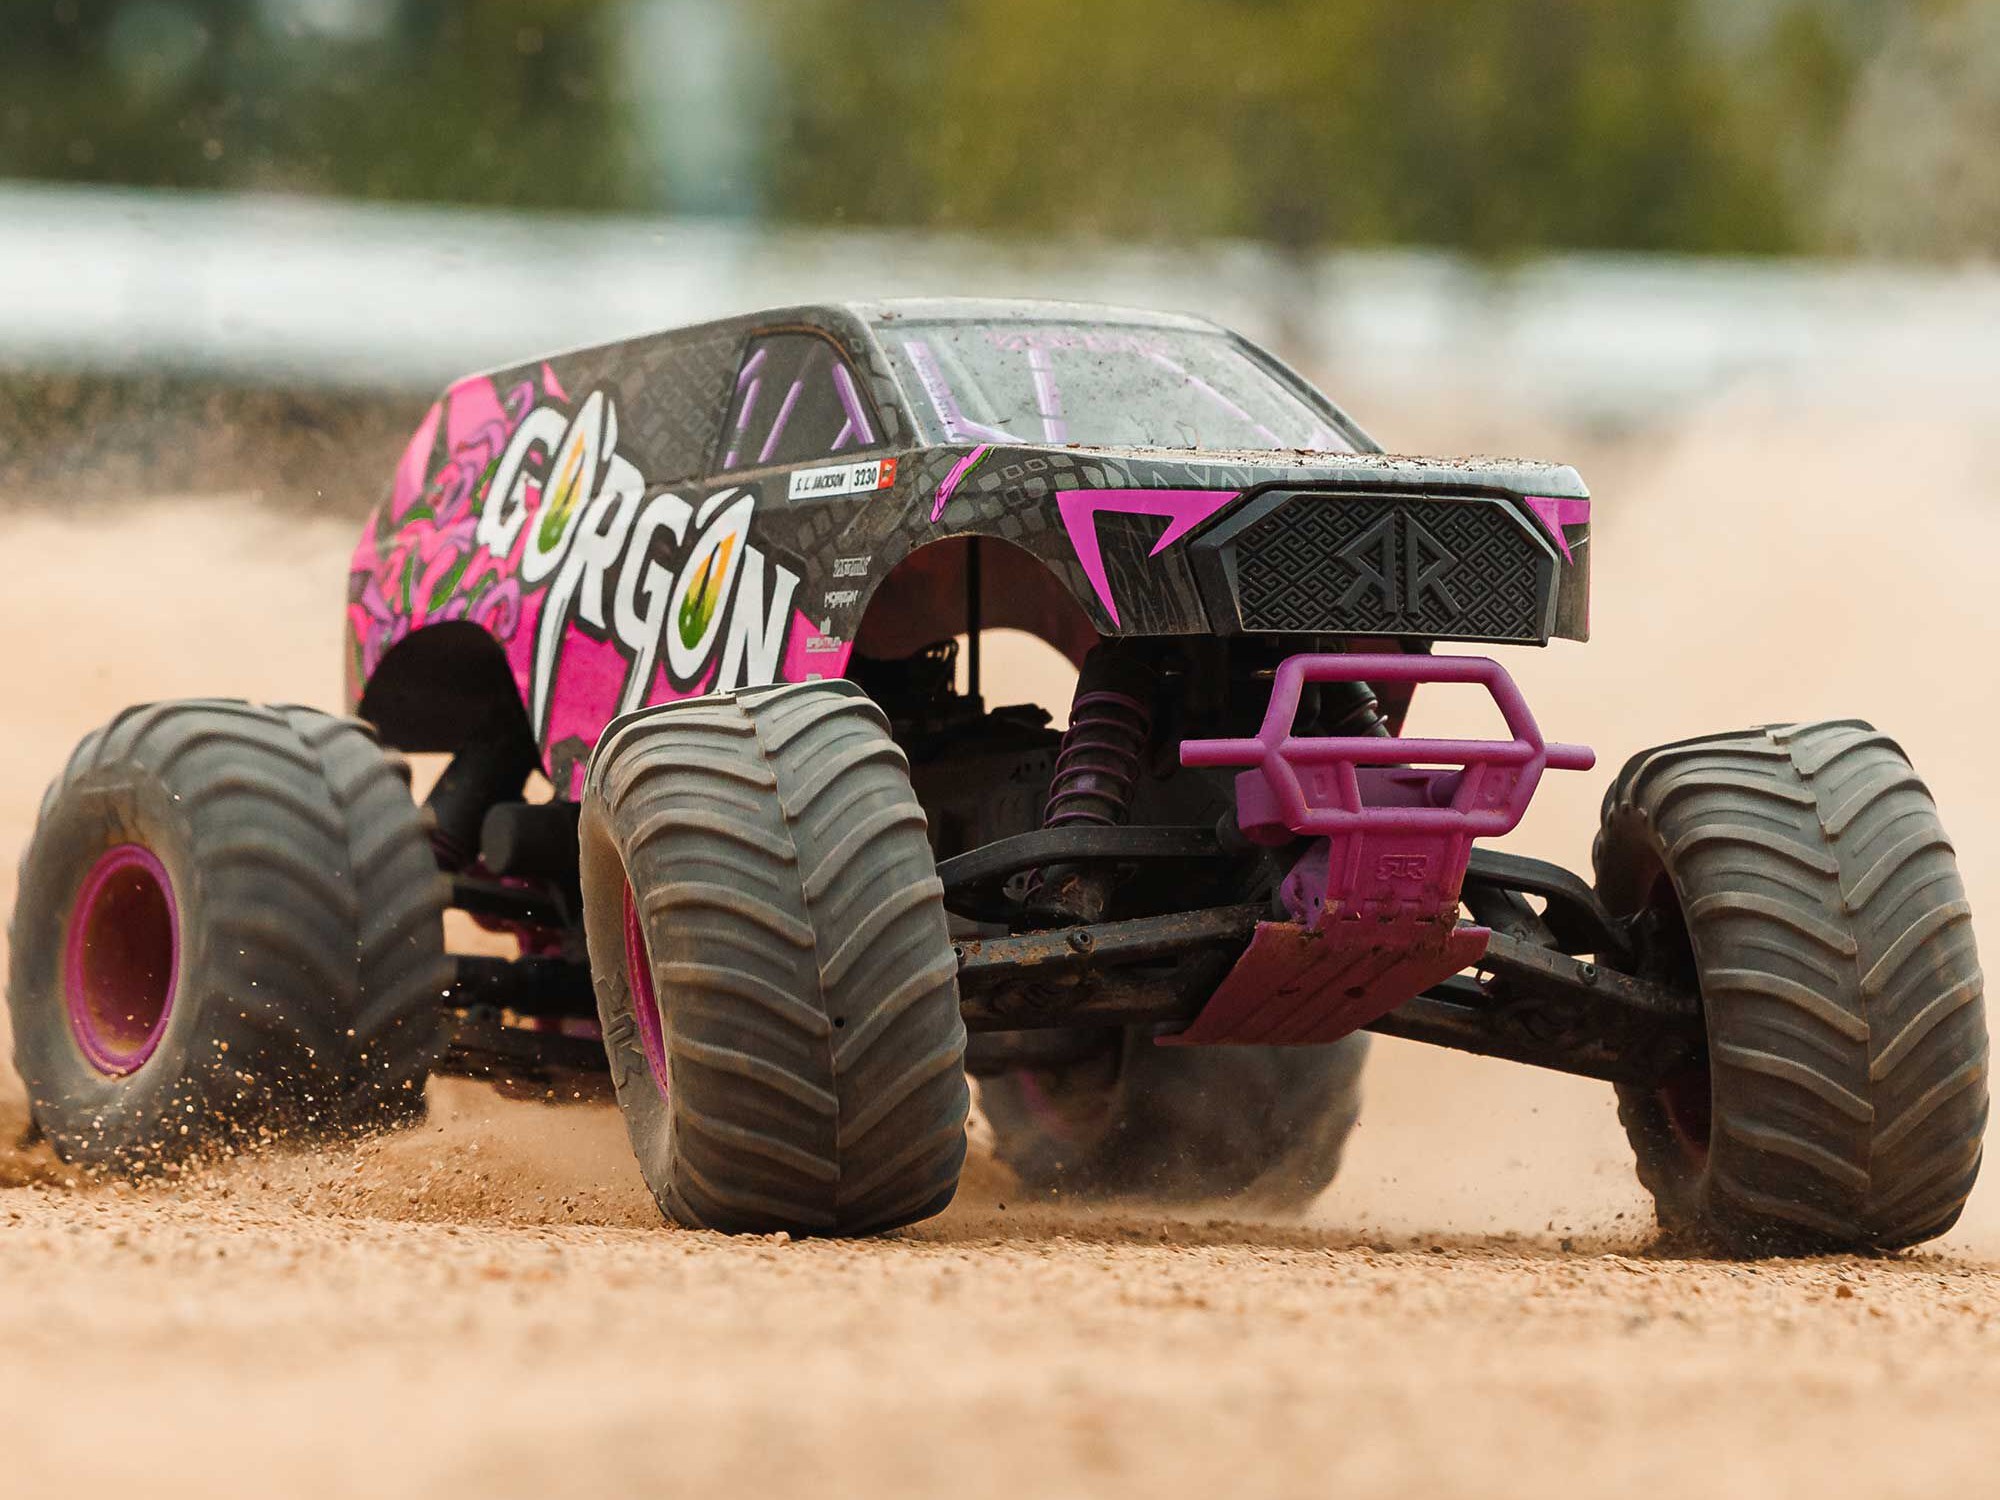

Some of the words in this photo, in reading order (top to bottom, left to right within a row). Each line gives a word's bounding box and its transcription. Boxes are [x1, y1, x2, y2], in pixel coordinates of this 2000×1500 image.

[812, 473, 846, 490] JACKSON
[854, 467, 877, 487] 3230
[476, 390, 800, 743] GORGON
